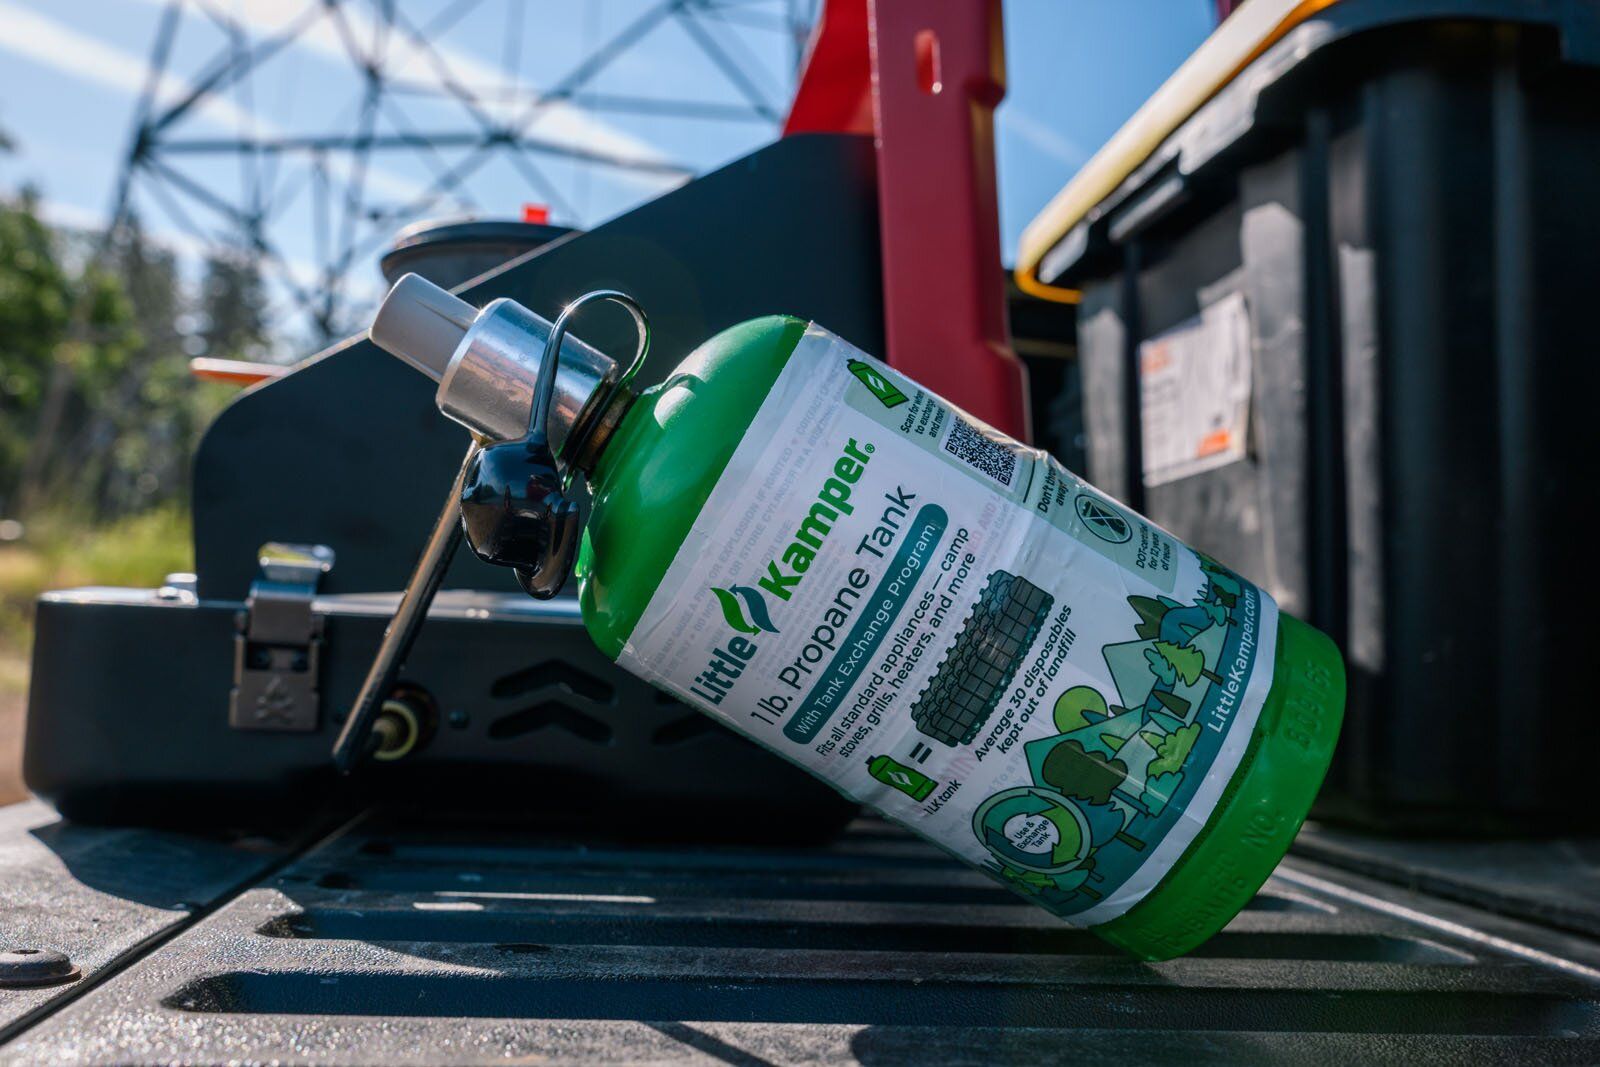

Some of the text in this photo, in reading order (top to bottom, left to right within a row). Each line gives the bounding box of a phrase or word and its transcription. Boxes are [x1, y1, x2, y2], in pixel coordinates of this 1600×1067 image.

[900, 413, 916, 434] Scan
[908, 403, 919, 415] for
[914, 398, 936, 435] to exchange
[928, 421, 941, 438] and
[1037, 484, 1054, 514] Don't
[854, 485, 916, 559] Tank
[1147, 556, 1158, 570] for
[1149, 547, 1161, 558] 12
[1160, 558, 1170, 571] of
[777, 567, 870, 691] Propane
[794, 524, 936, 734] With Tank Exchange Program
[689, 636, 758, 706] Little
[838, 725, 873, 758] stoves,
[866, 692, 898, 726] grills,
[887, 631, 936, 690] heaters,
[929, 594, 953, 629] and
[947, 552, 976, 596] more
[1207, 592, 1255, 733] LittleKamper.com
[974, 604, 1072, 762] Average 30 disposables
[996, 627, 1077, 755] kept out of landfill
[750, 711, 775, 726] 1
[756, 695, 793, 718] lb.
[815, 739, 836, 757] Fits
[830, 726, 846, 742] all
[840, 672, 885, 730] standard
[927, 798, 944, 813] LK
[937, 779, 962, 803] tank
[1013, 821, 1035, 839] Use &
[1016, 819, 1050, 851] Exchange
[1030, 831, 1051, 848] Tank
